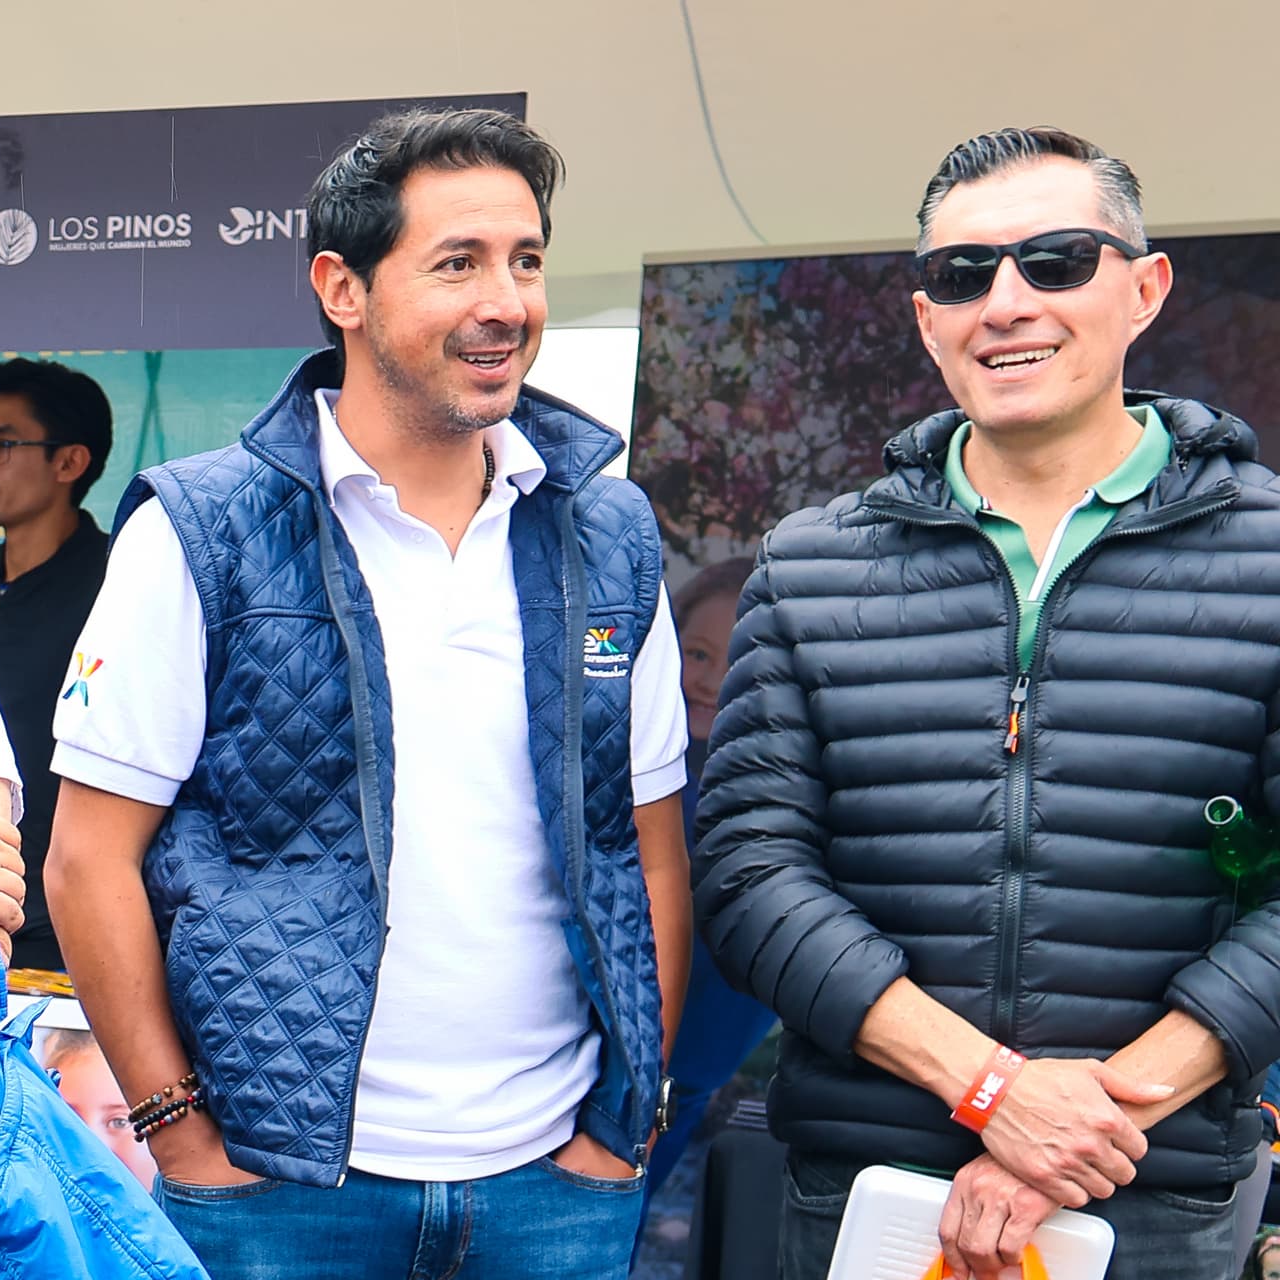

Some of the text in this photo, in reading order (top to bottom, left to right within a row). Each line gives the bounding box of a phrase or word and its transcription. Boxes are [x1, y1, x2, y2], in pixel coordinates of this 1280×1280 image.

[48, 213, 192, 241] LOS PINOS
[970, 1071, 1005, 1111] UHE
